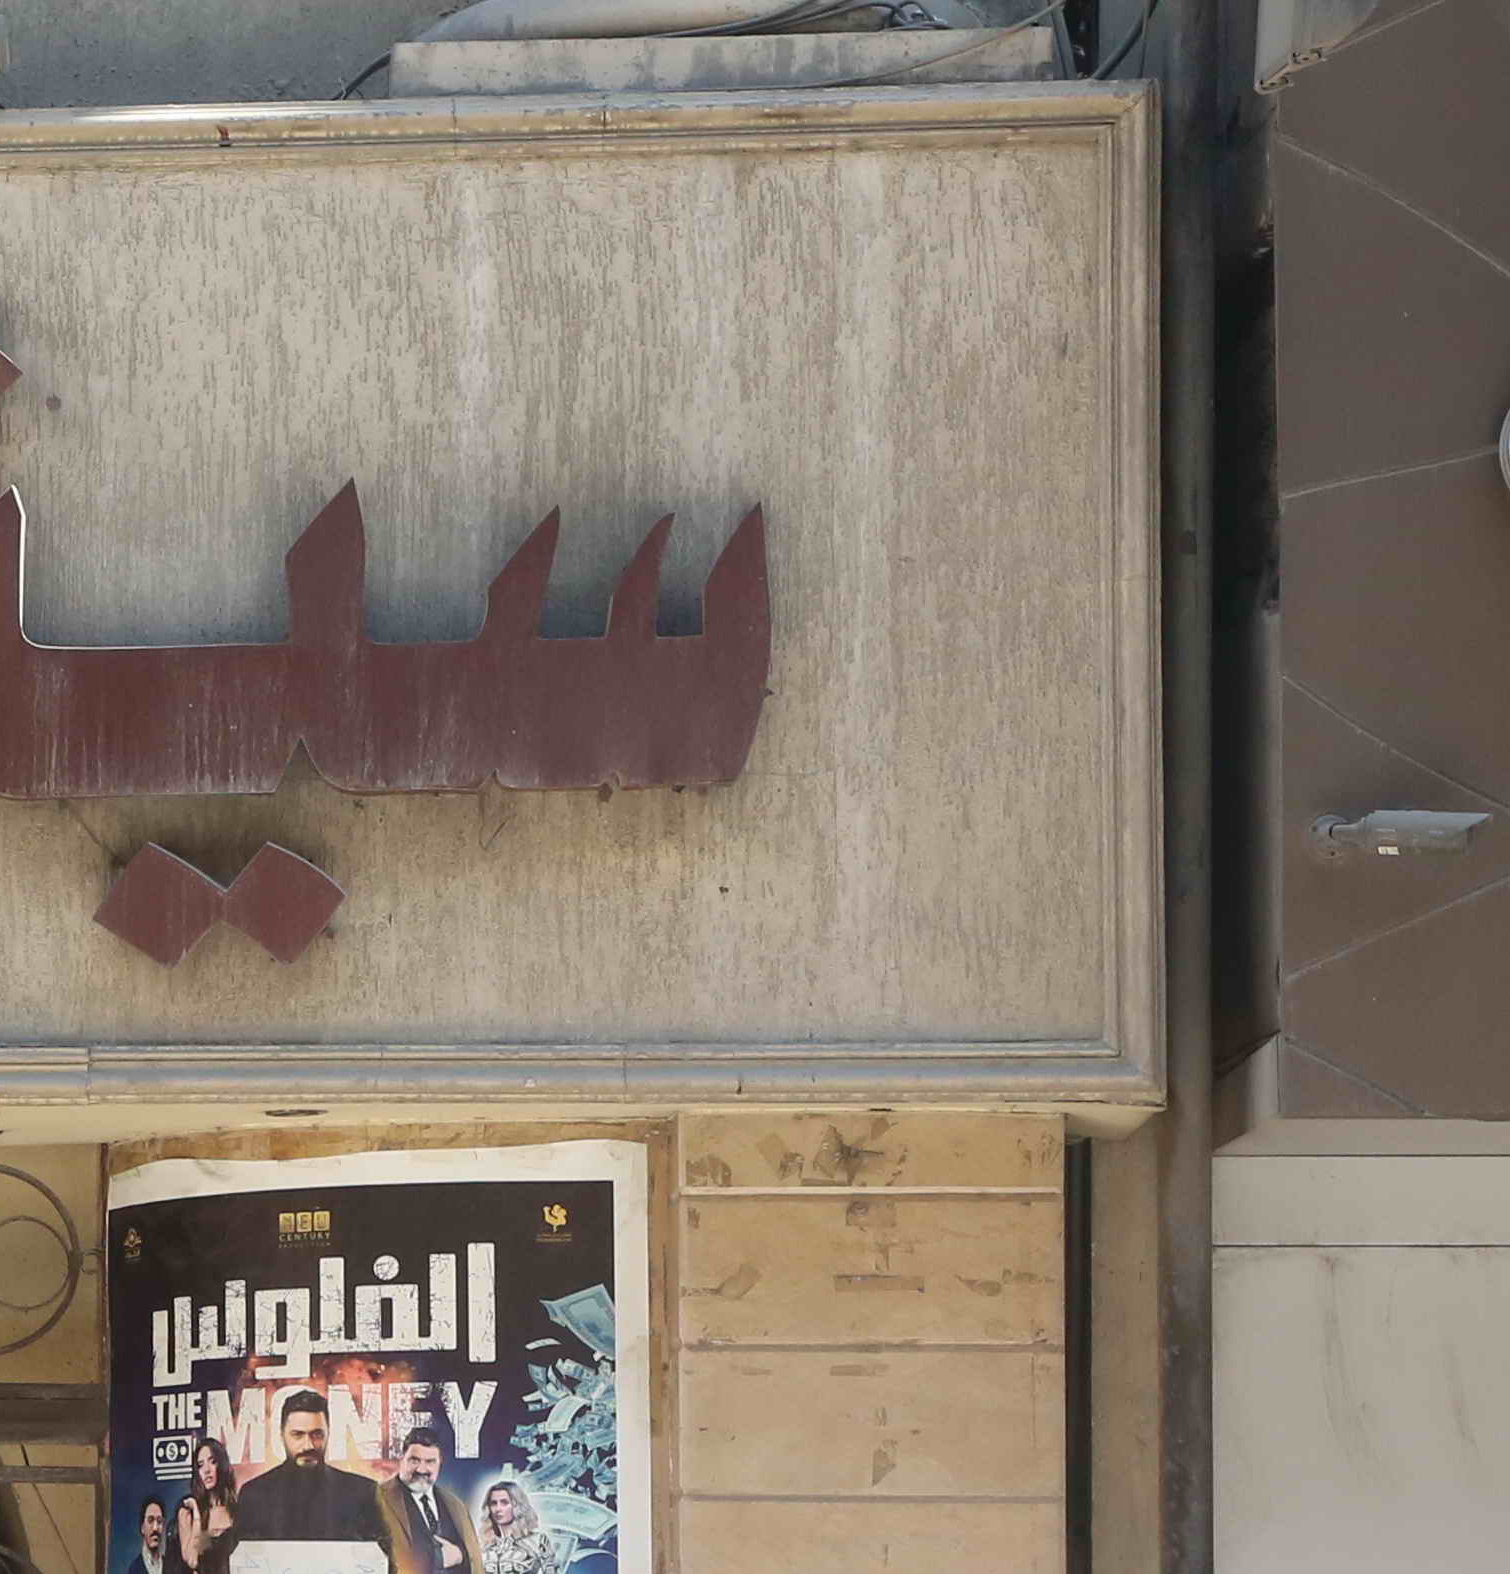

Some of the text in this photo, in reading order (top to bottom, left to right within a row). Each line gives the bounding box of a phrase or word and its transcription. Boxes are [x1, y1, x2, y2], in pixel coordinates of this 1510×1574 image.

[278, 1232, 331, 1242] CENTURY
[152, 1242, 497, 1388] الفلوس
[152, 1391, 202, 1431] THE
